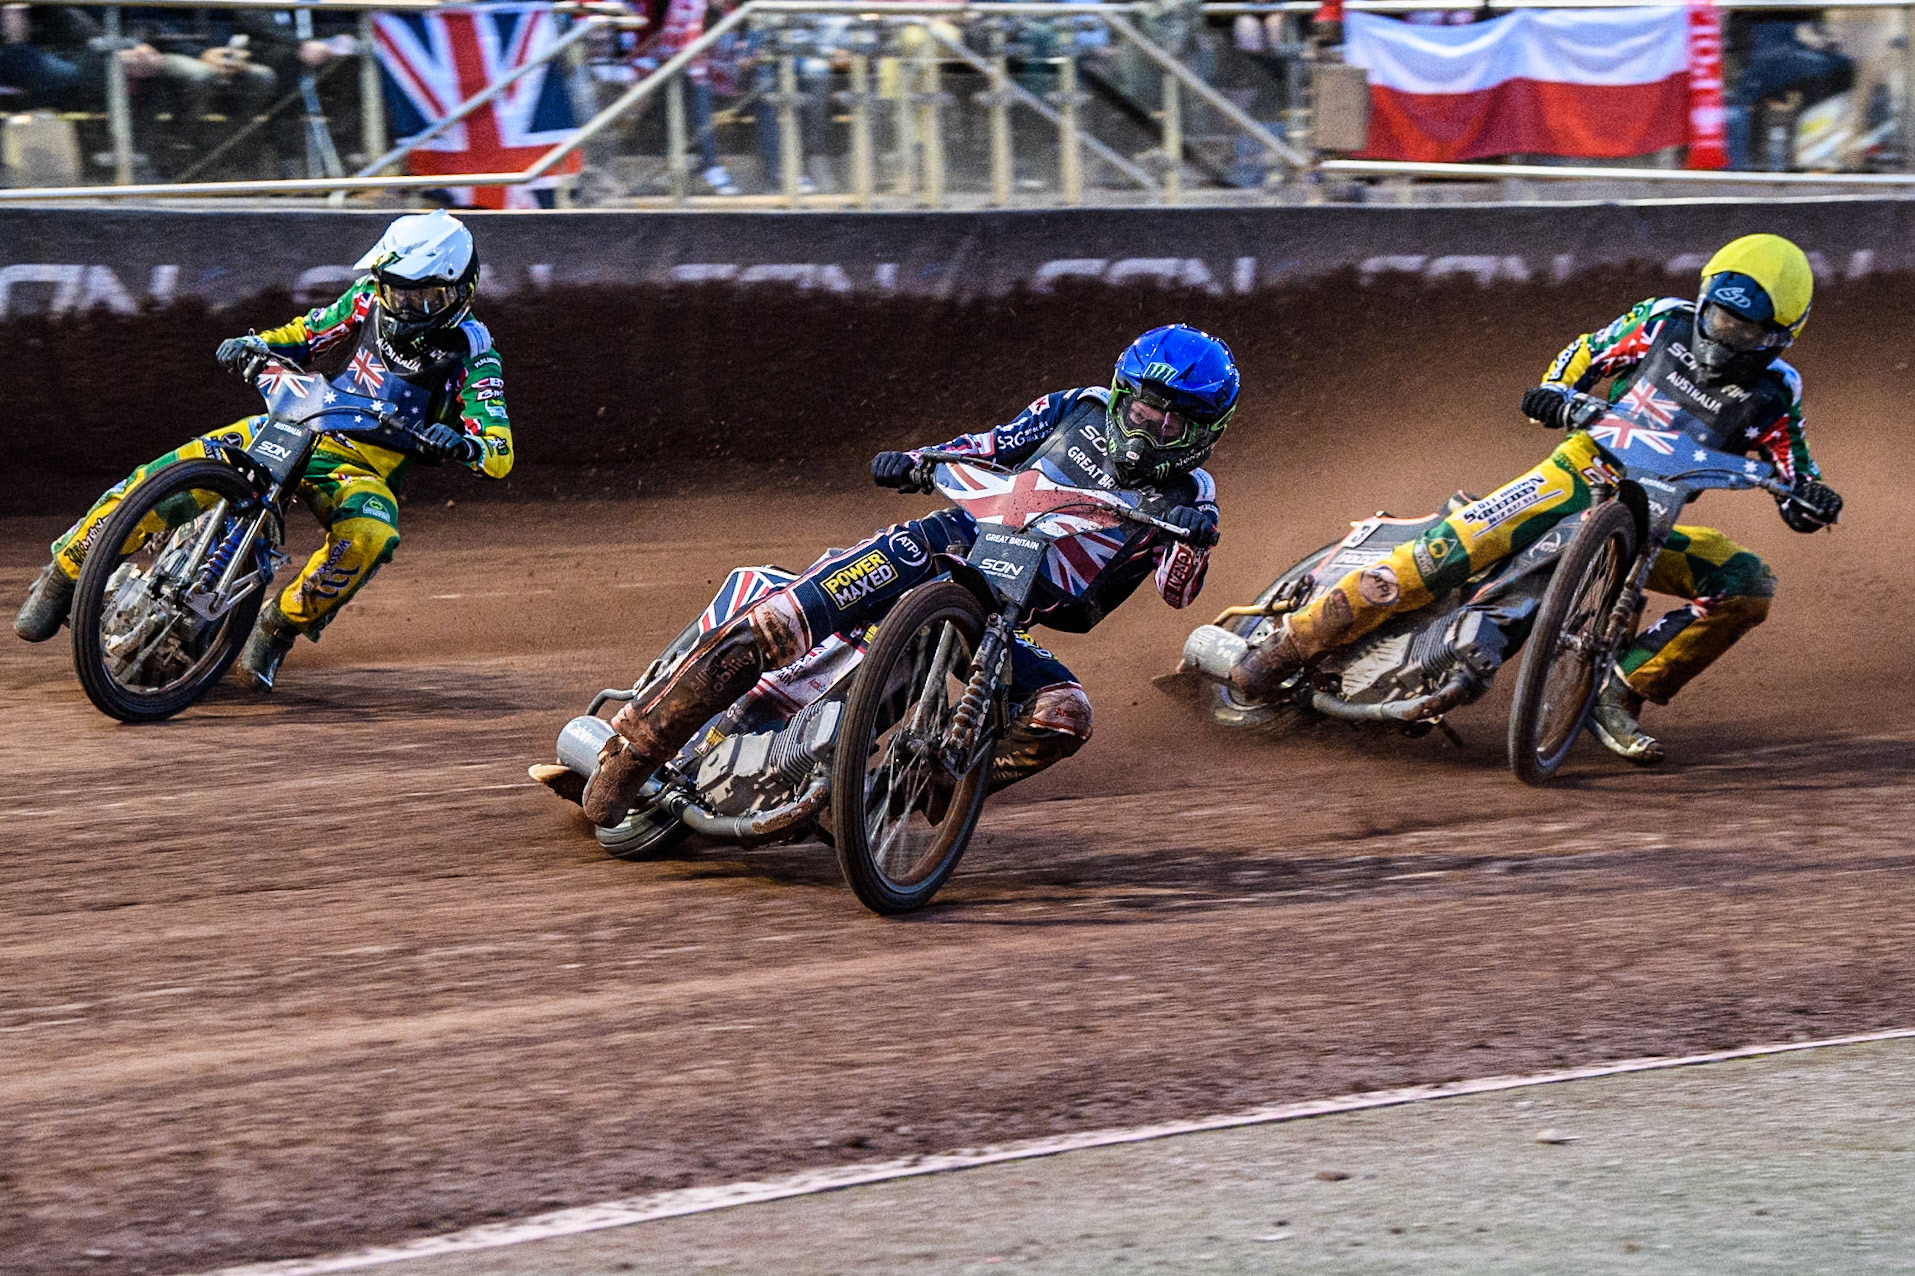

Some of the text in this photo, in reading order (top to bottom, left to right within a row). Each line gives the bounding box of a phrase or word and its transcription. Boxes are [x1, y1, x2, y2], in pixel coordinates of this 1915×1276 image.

[1667, 342, 1698, 371] SO
[1666, 371, 1723, 415] AUSTRALIA
[273, 421, 303, 437] AUSTRALIA
[997, 431, 1026, 451] SRG
[1079, 424, 1109, 457] SO
[257, 440, 292, 459] SON
[1067, 446, 1104, 479] GREAT
[896, 536, 922, 559] ATPI
[985, 533, 1040, 551] GREAT BRITAIN
[825, 553, 886, 594] POWER
[978, 558, 1024, 576] SON
[834, 564, 893, 607] MAXED
